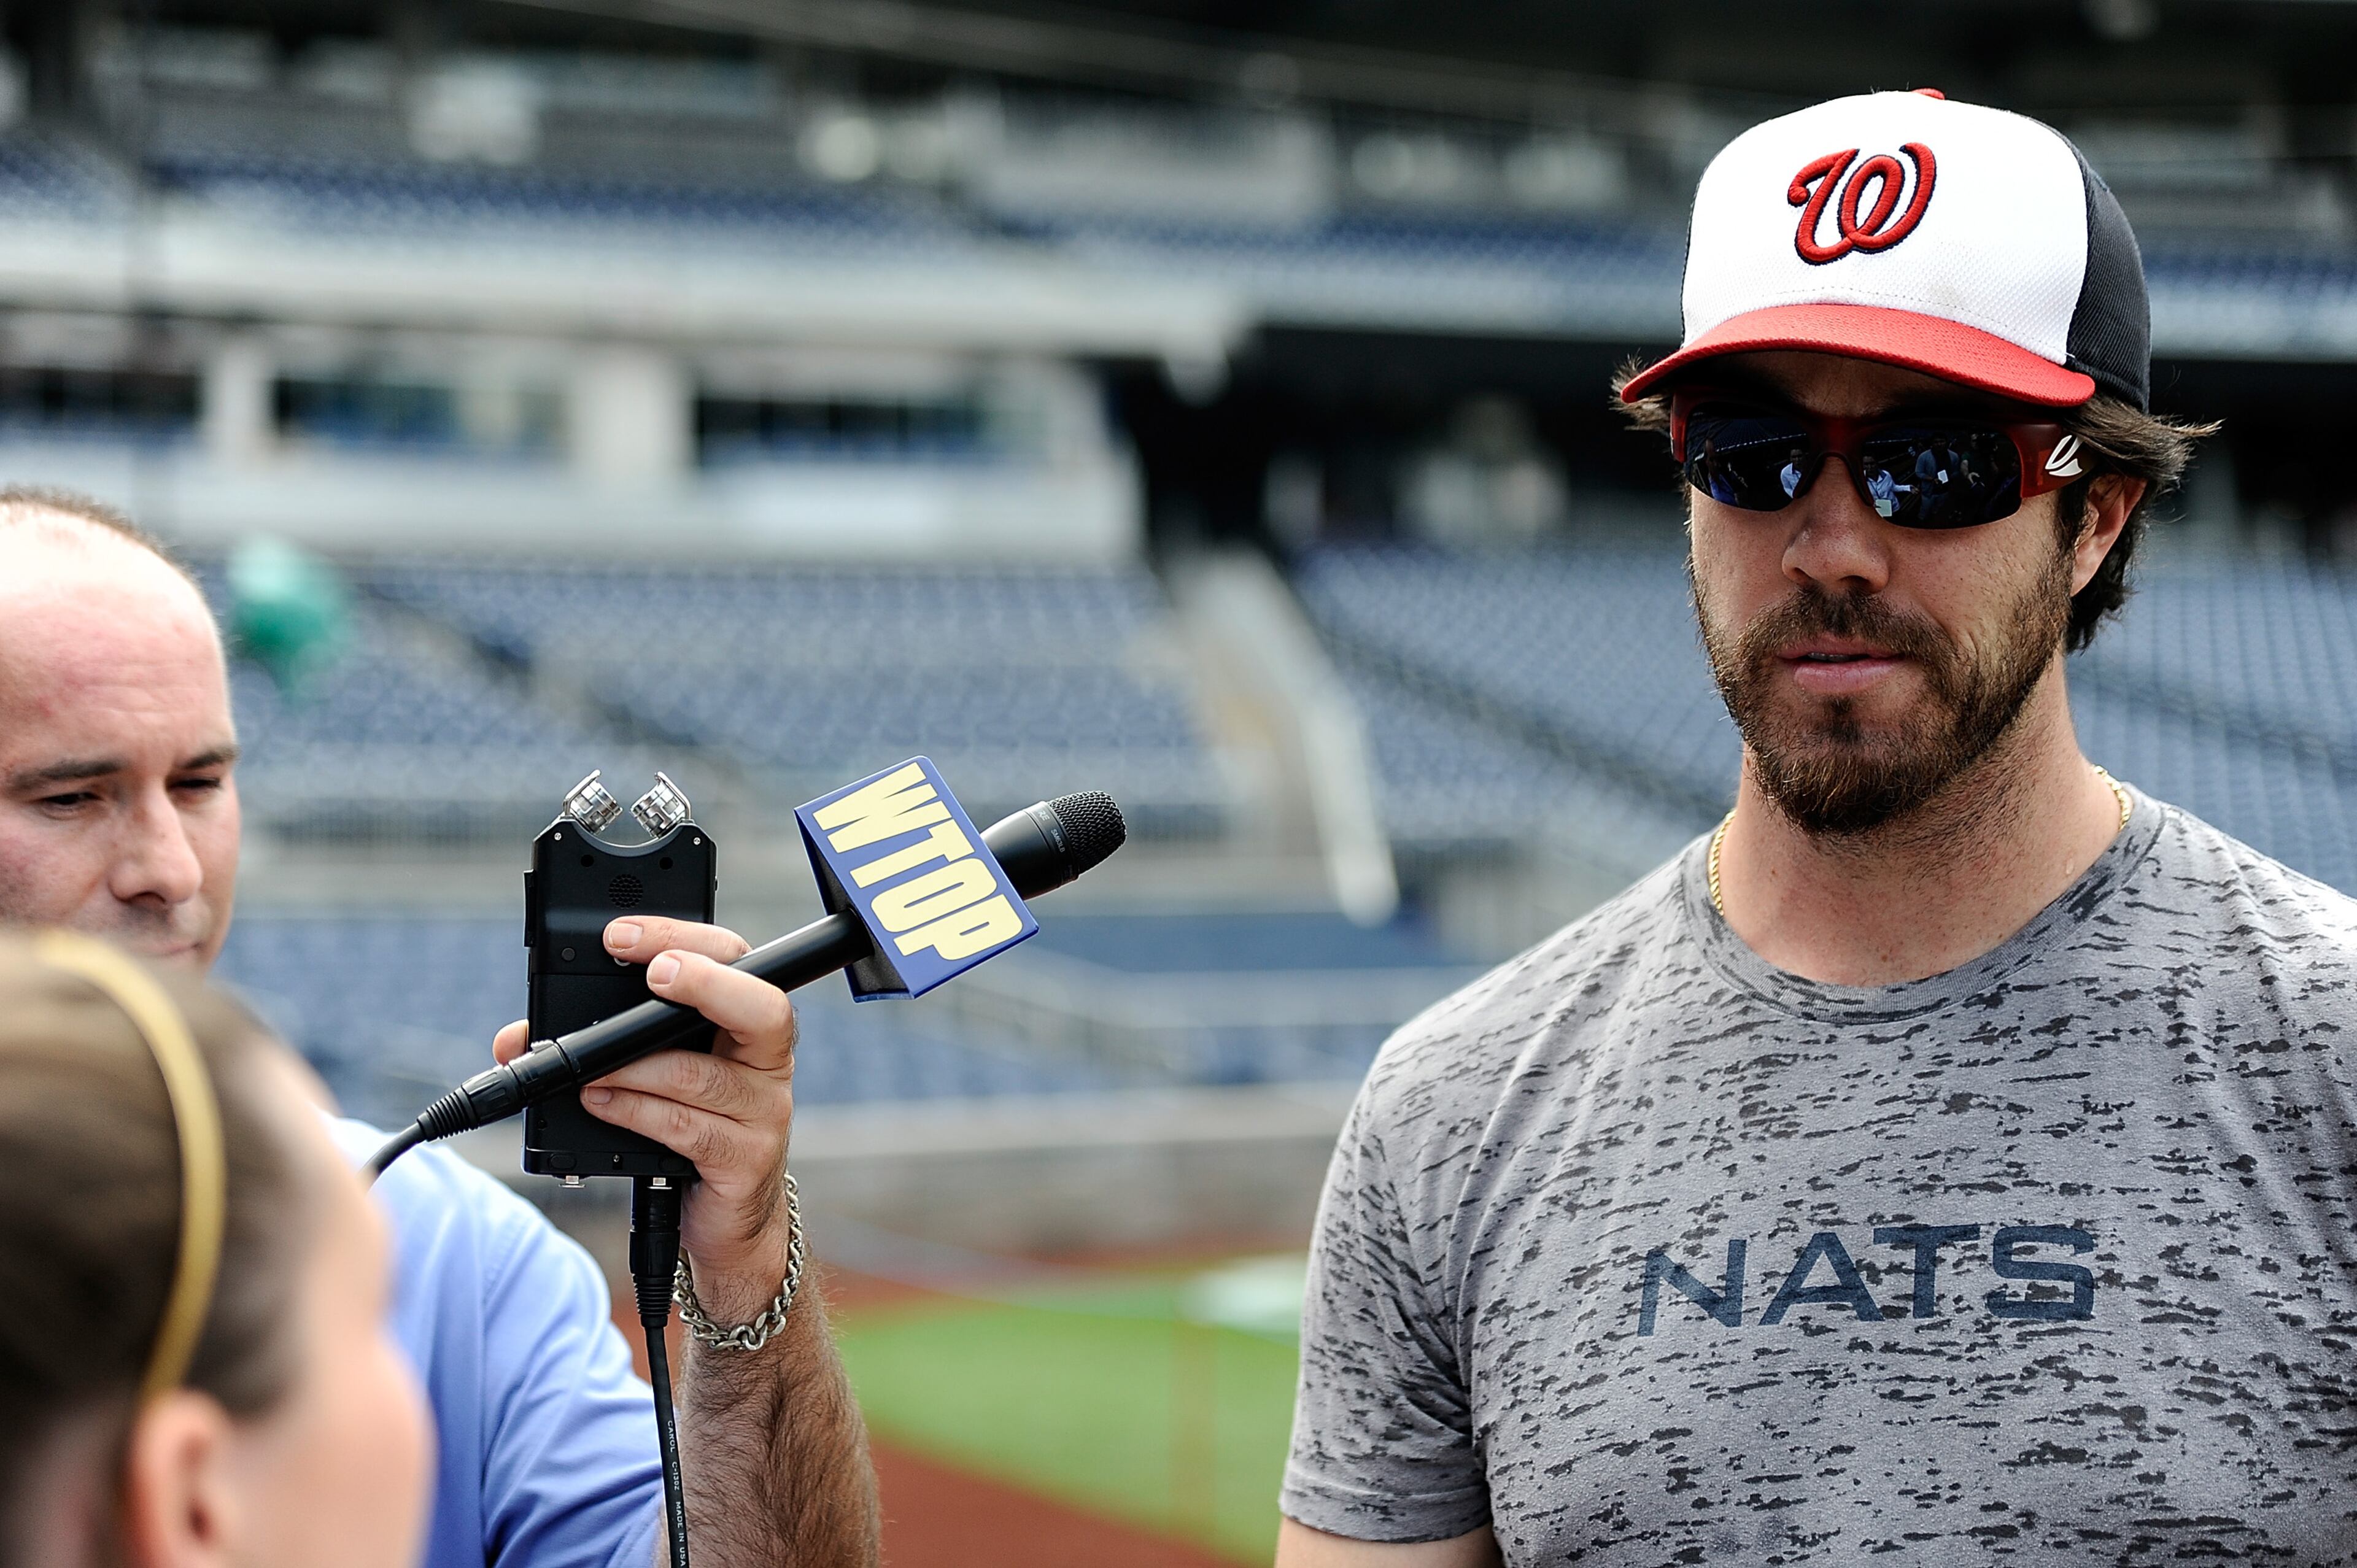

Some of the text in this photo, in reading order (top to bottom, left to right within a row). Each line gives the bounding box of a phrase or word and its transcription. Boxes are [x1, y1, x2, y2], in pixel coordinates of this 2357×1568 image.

[1787, 142, 1937, 266] W
[813, 762, 1023, 960] WTOP
[1637, 1223, 2095, 1337] NATS
[667, 1420, 676, 1453] CAROL
[678, 1533, 684, 1542] IN
